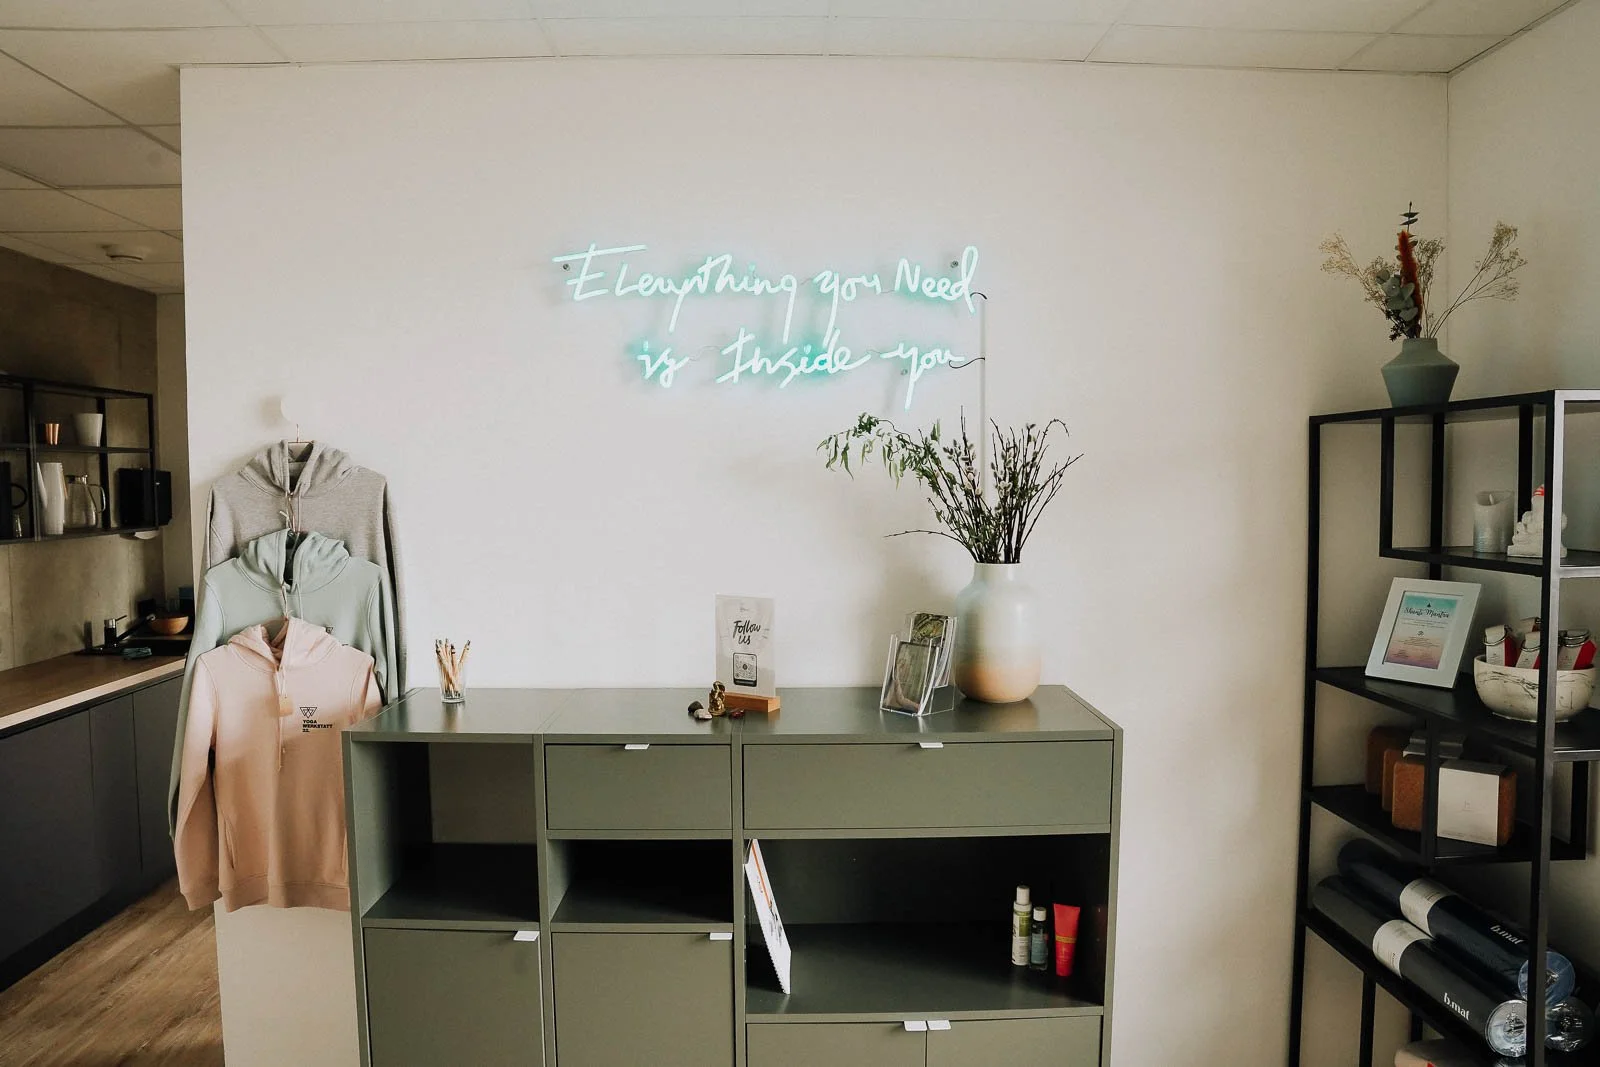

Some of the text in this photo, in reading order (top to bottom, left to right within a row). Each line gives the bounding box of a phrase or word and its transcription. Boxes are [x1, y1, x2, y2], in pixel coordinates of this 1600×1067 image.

[812, 270, 882, 348] you
[894, 246, 979, 313] Need
[637, 328, 965, 412] is Inside you
[733, 620, 761, 638] Follow
[1444, 991, 1470, 1021] b.mat
